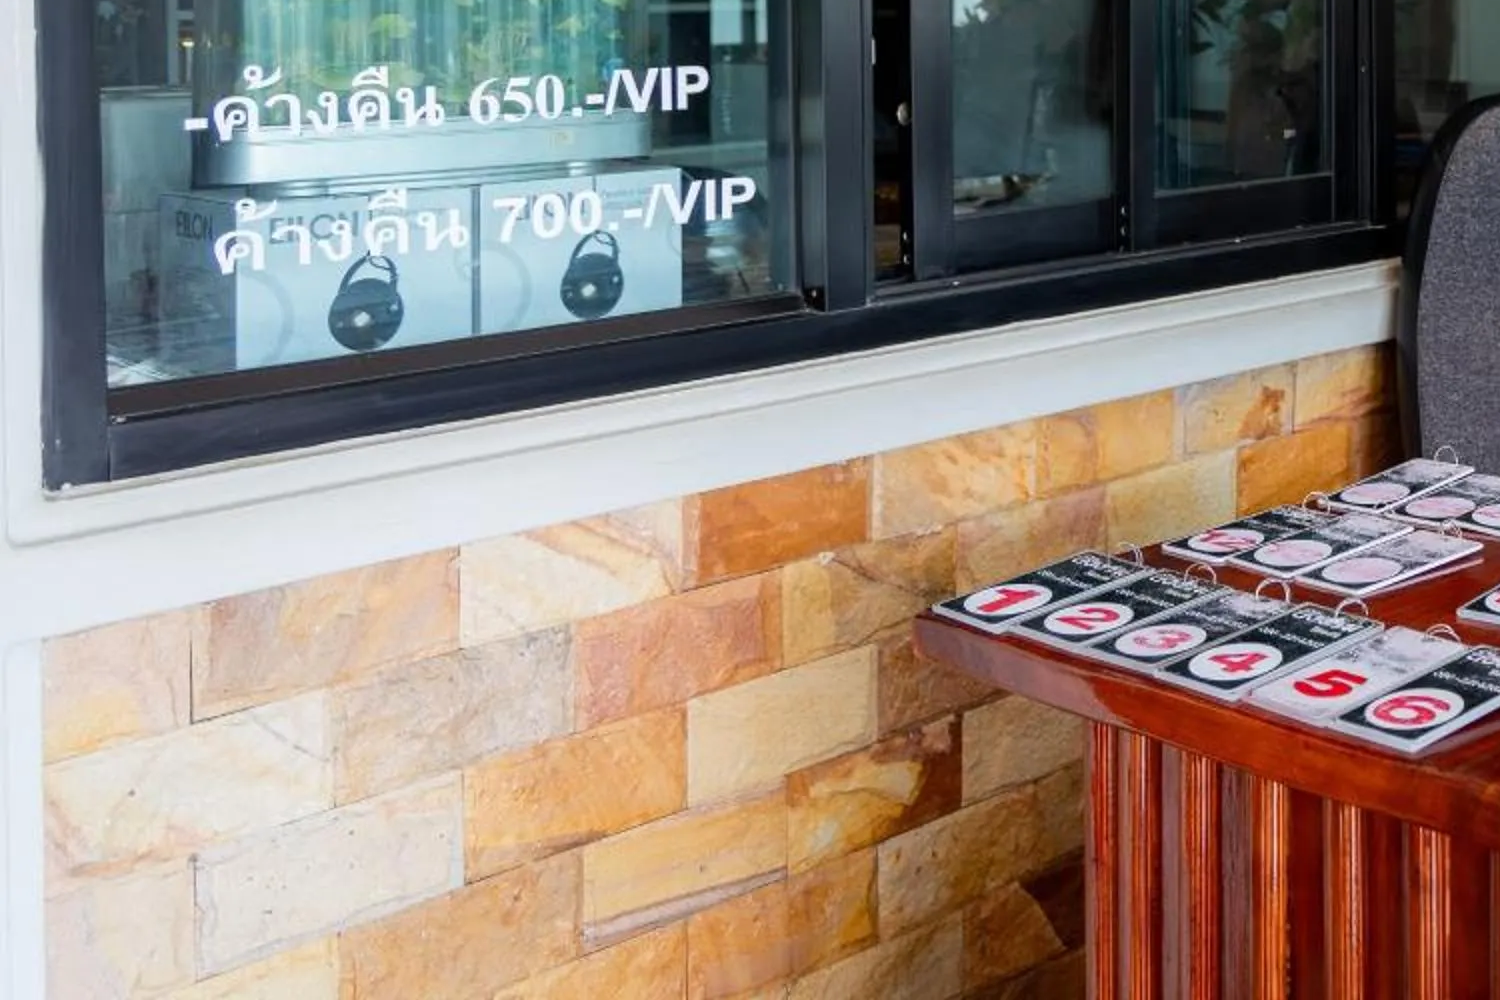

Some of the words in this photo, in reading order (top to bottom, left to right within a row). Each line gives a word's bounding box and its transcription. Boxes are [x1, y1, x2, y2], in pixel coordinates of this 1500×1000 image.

[976, 585, 1042, 614] 1
[1056, 607, 1121, 632] 2
[1132, 628, 1193, 651] 3
[1207, 650, 1271, 674] 4
[1292, 668, 1369, 699] 5
[1373, 694, 1452, 726] 6
